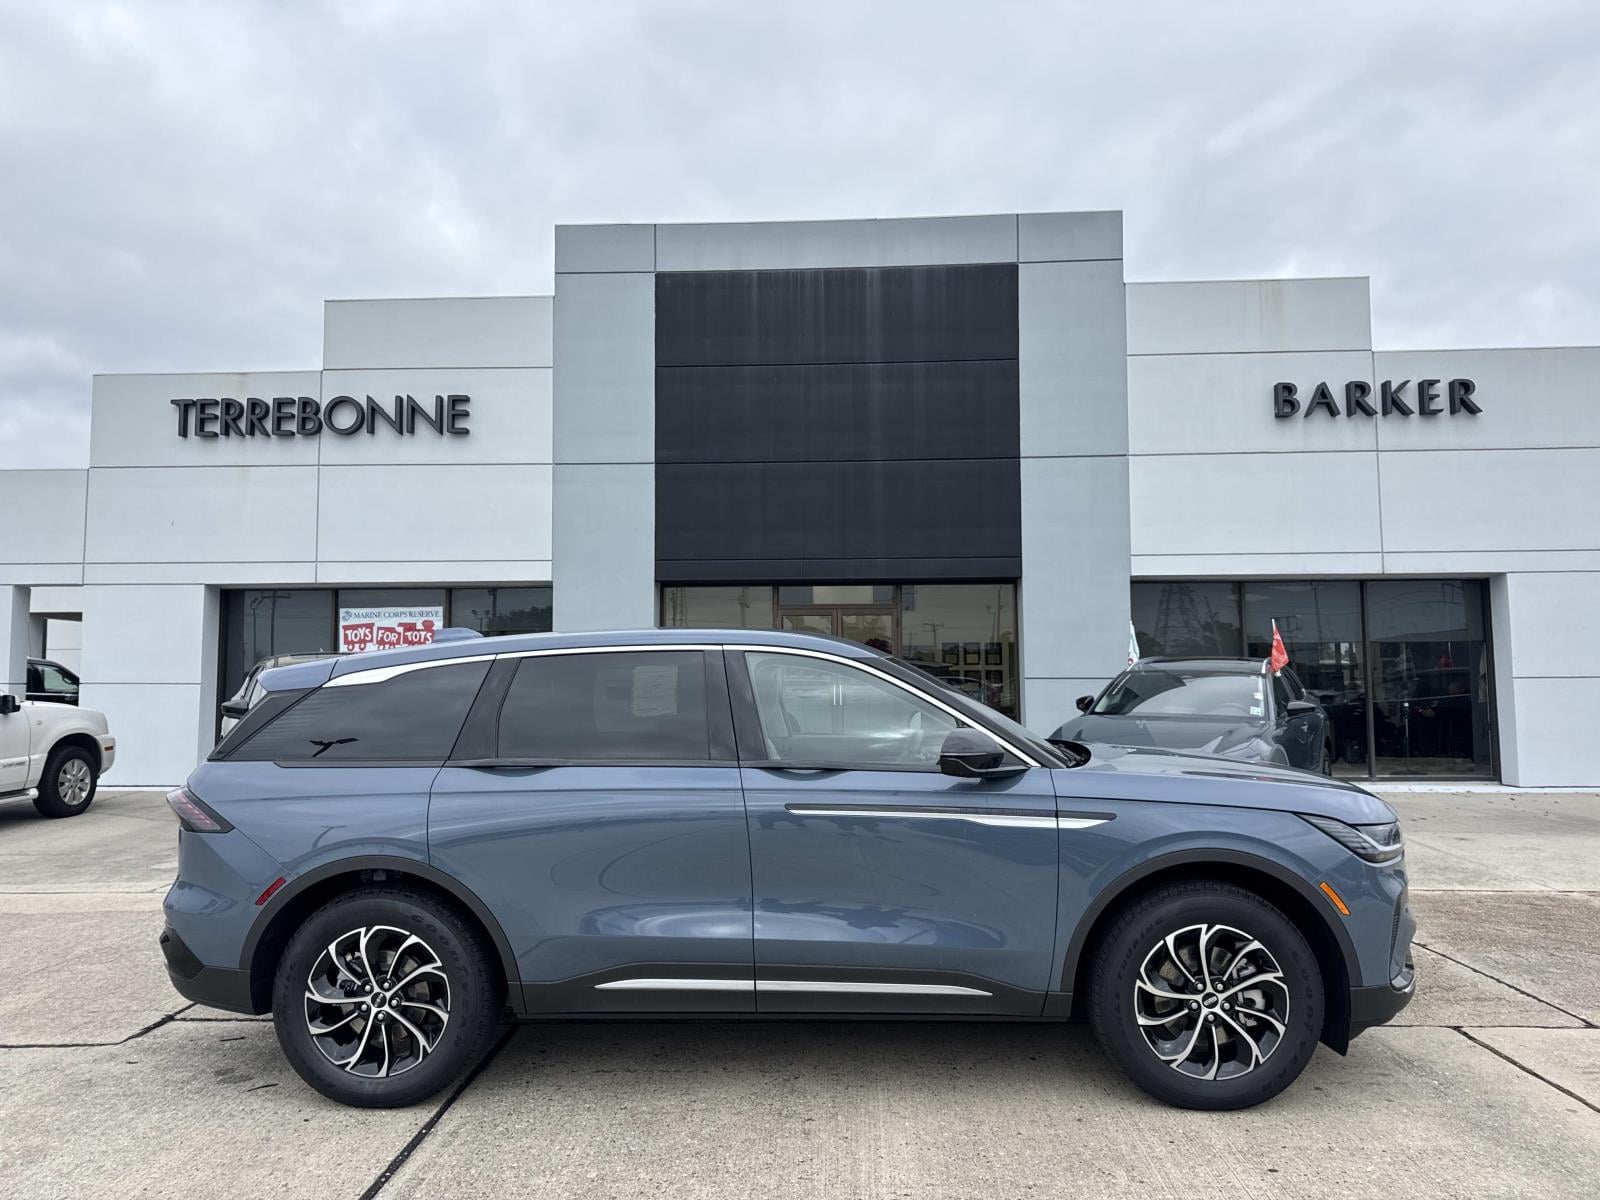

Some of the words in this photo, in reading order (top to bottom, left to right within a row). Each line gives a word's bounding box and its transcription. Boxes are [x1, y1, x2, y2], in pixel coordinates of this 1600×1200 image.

[1273, 378, 1483, 418] BARKER
[170, 394, 471, 438] TERREBONNE
[353, 611, 381, 619] MARINE
[383, 610, 408, 618] CORPS
[408, 610, 440, 618] RESERVE
[345, 627, 372, 642] TOYS
[378, 629, 398, 643] FOR
[404, 630, 433, 644] TOTS
